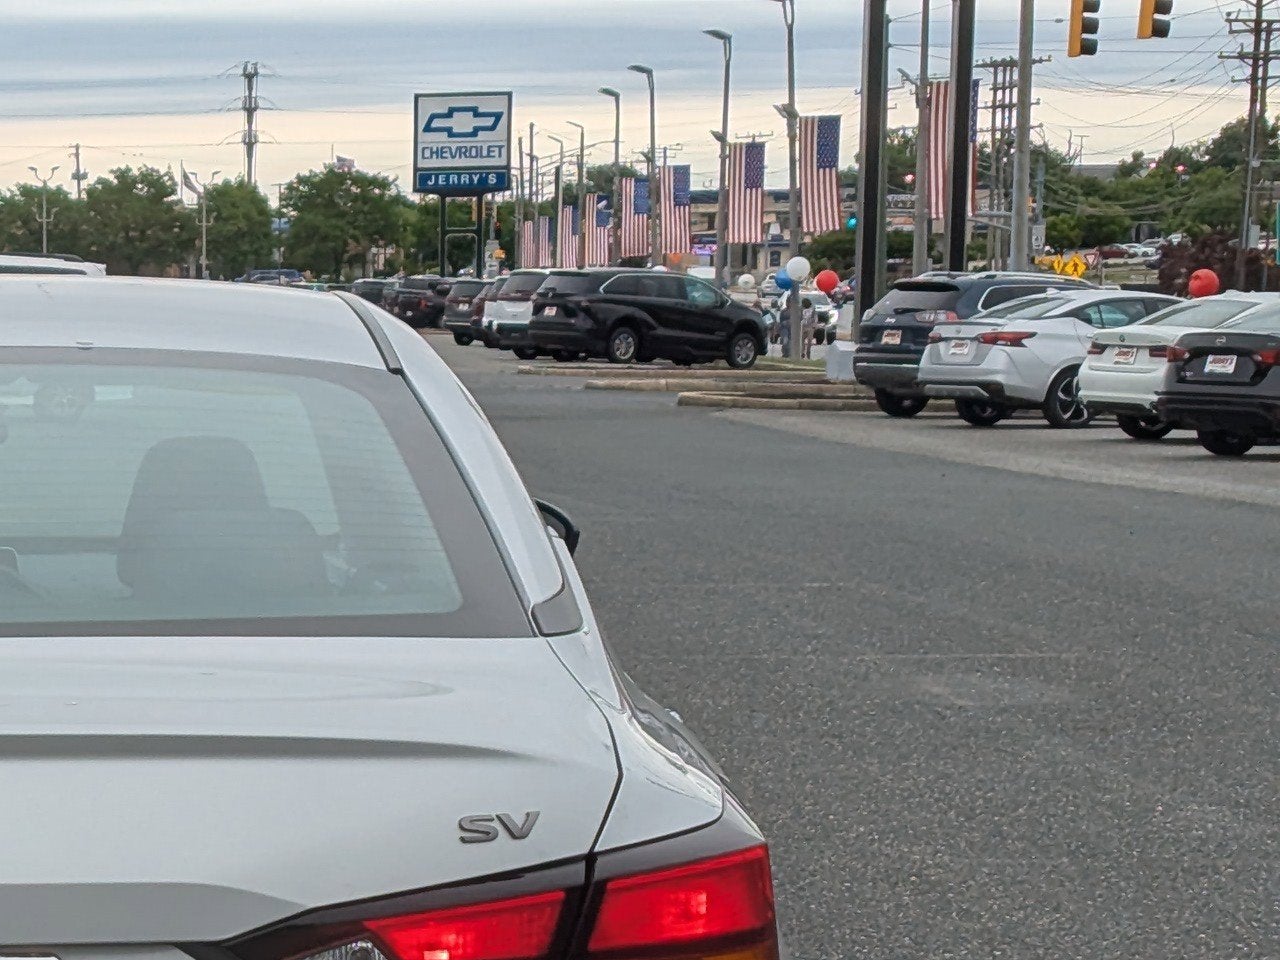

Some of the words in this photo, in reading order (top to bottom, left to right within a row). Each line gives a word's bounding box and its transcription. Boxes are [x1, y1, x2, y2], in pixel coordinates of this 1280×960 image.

[421, 145, 505, 159] CHEVROLET
[427, 173, 497, 186] JERRY'S
[459, 811, 541, 843] SV
